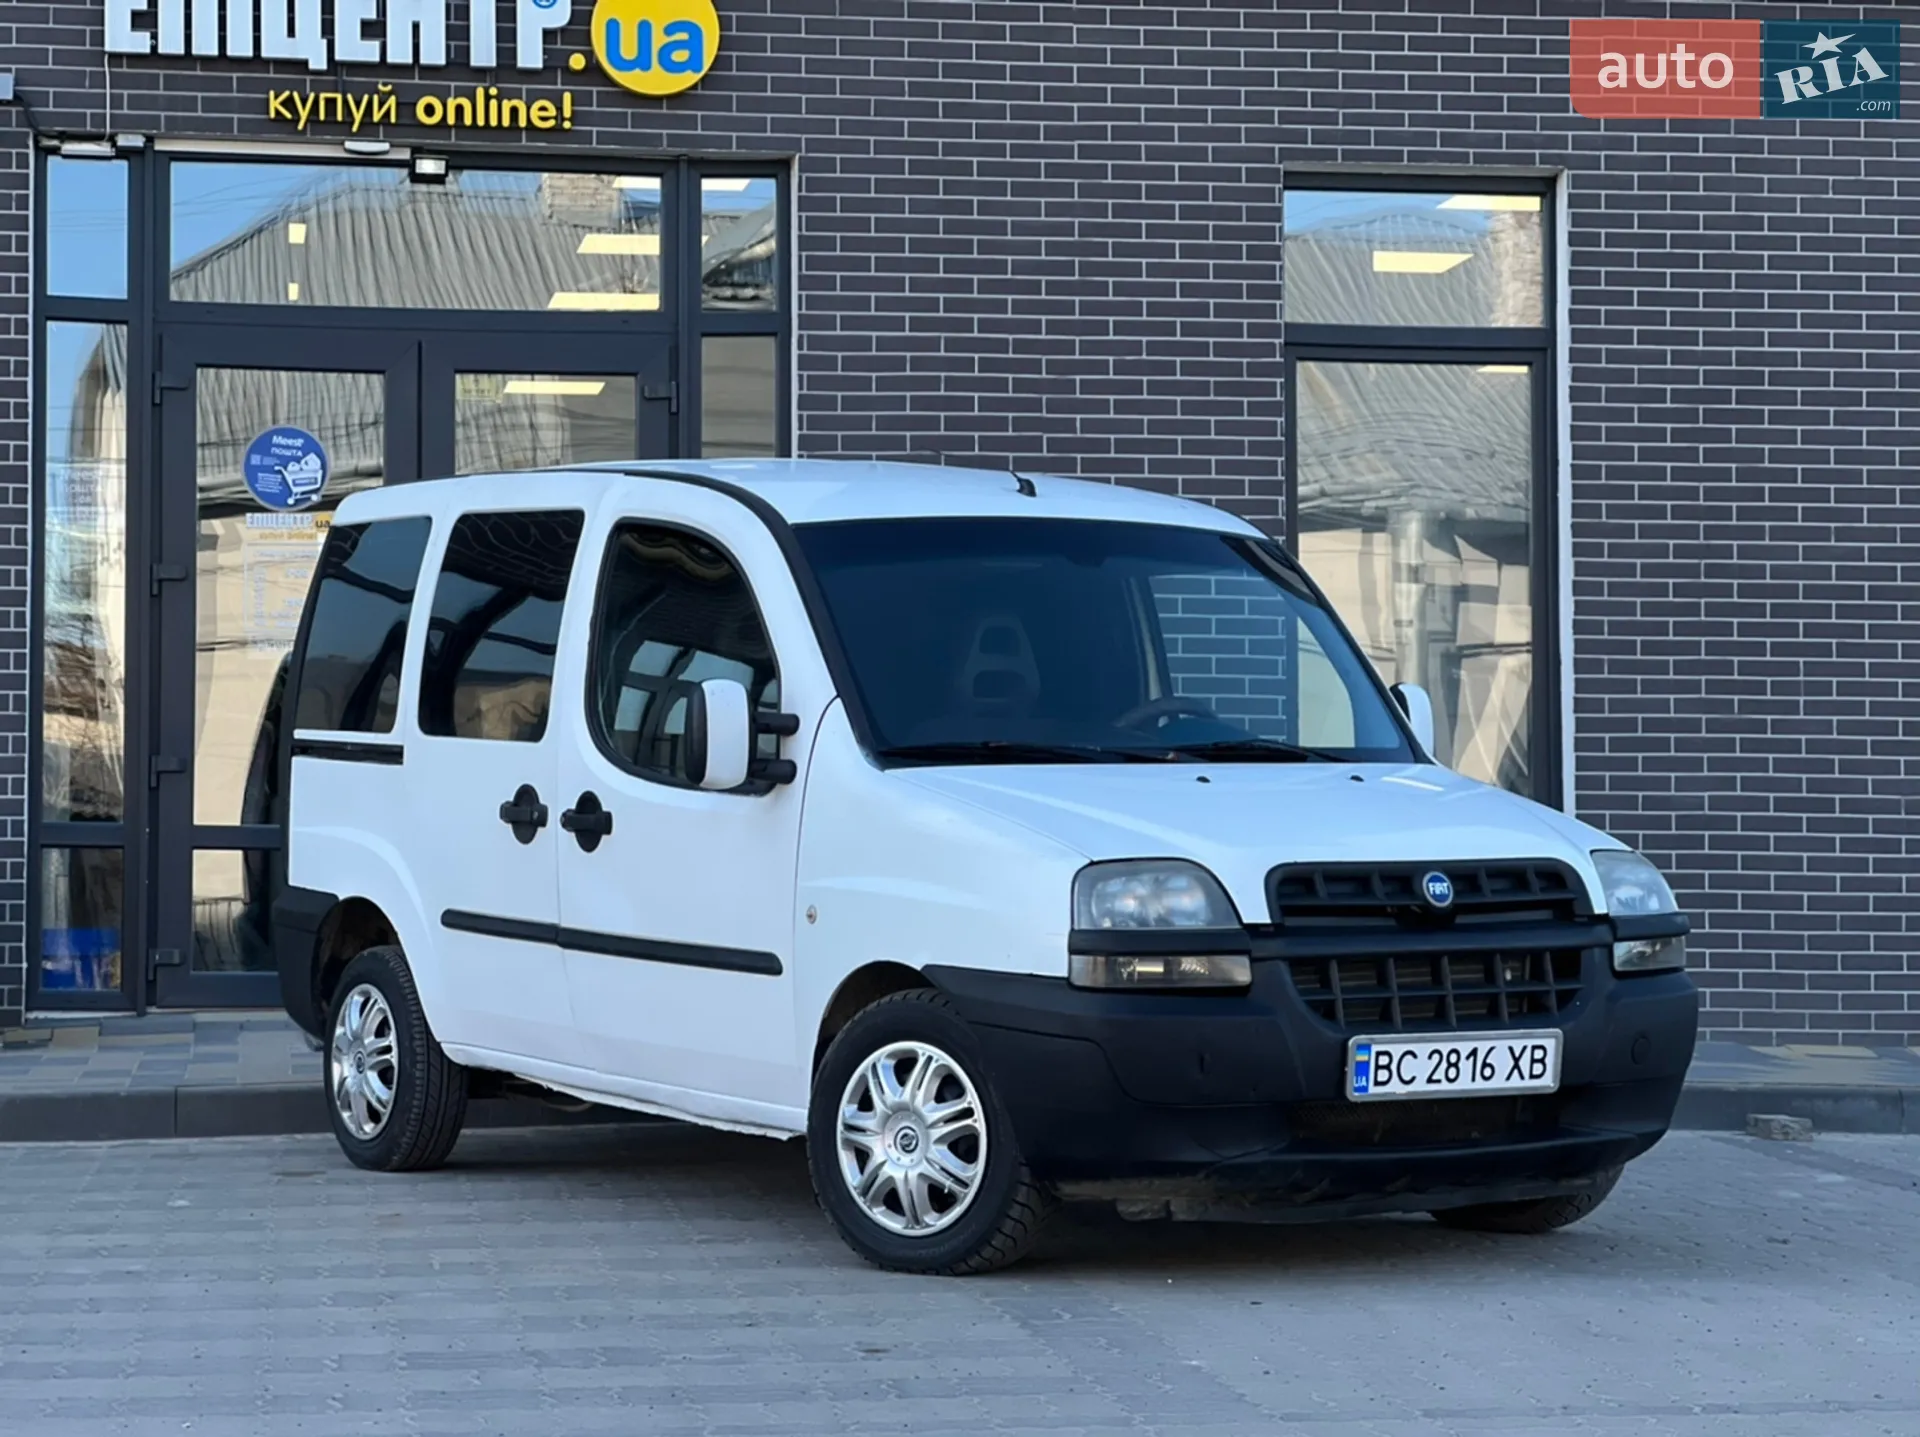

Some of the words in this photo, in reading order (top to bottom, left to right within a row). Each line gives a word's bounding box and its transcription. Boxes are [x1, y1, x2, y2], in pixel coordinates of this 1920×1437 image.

[268, 83, 396, 132] купуй
[415, 86, 572, 130] online!
[1428, 882, 1449, 895] FIAT
[1373, 1050, 1418, 1087] BC
[1426, 1046, 1496, 1084] 2816
[1505, 1044, 1548, 1081] XB
